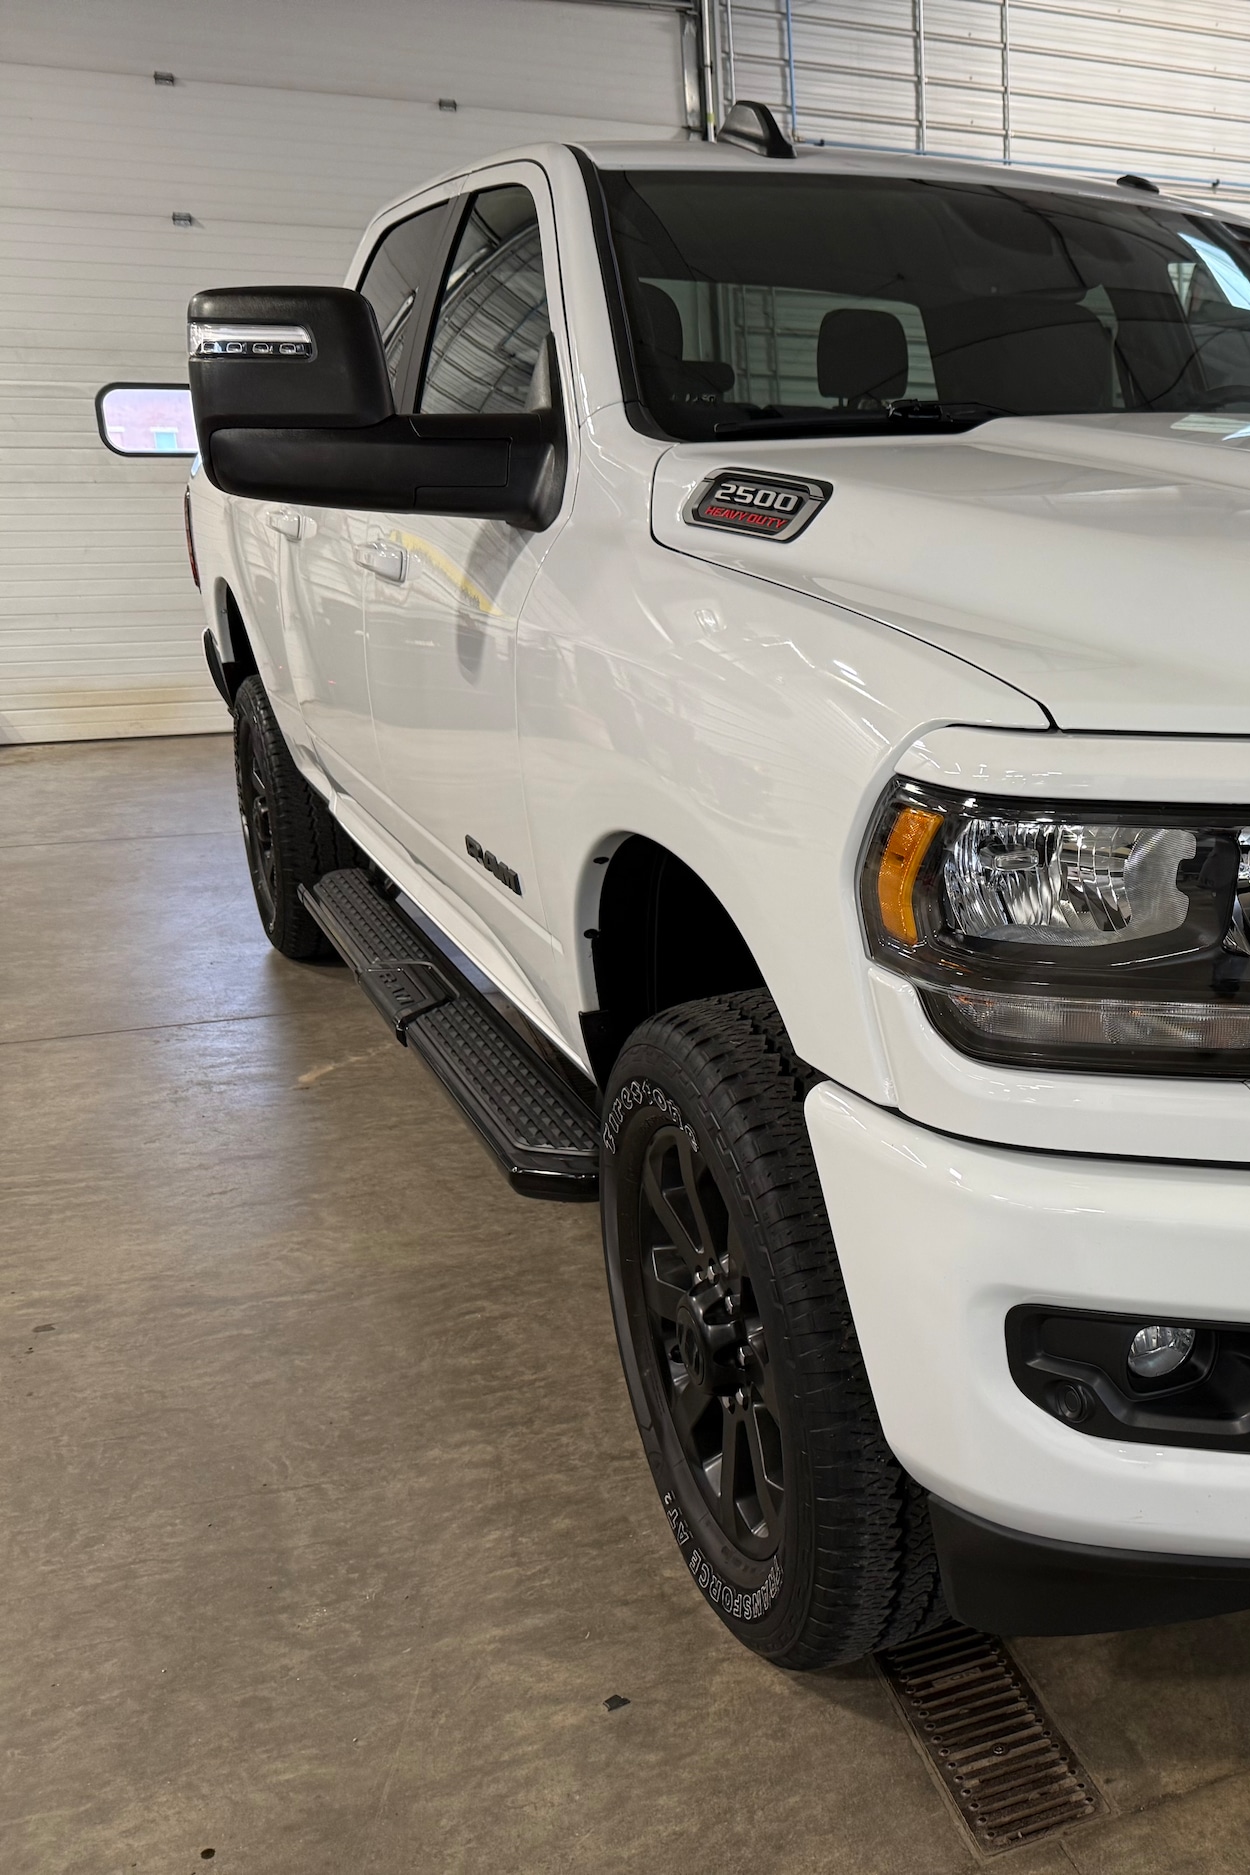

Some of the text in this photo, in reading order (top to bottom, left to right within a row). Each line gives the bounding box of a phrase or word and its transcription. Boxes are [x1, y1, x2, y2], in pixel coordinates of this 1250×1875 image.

[714, 483, 799, 512] 2500
[705, 506, 788, 529] HEAVY DUTY
[465, 834, 522, 896] RAM
[379, 972, 415, 1005] RAM
[689, 1548, 784, 1620] TRANSFORCE
